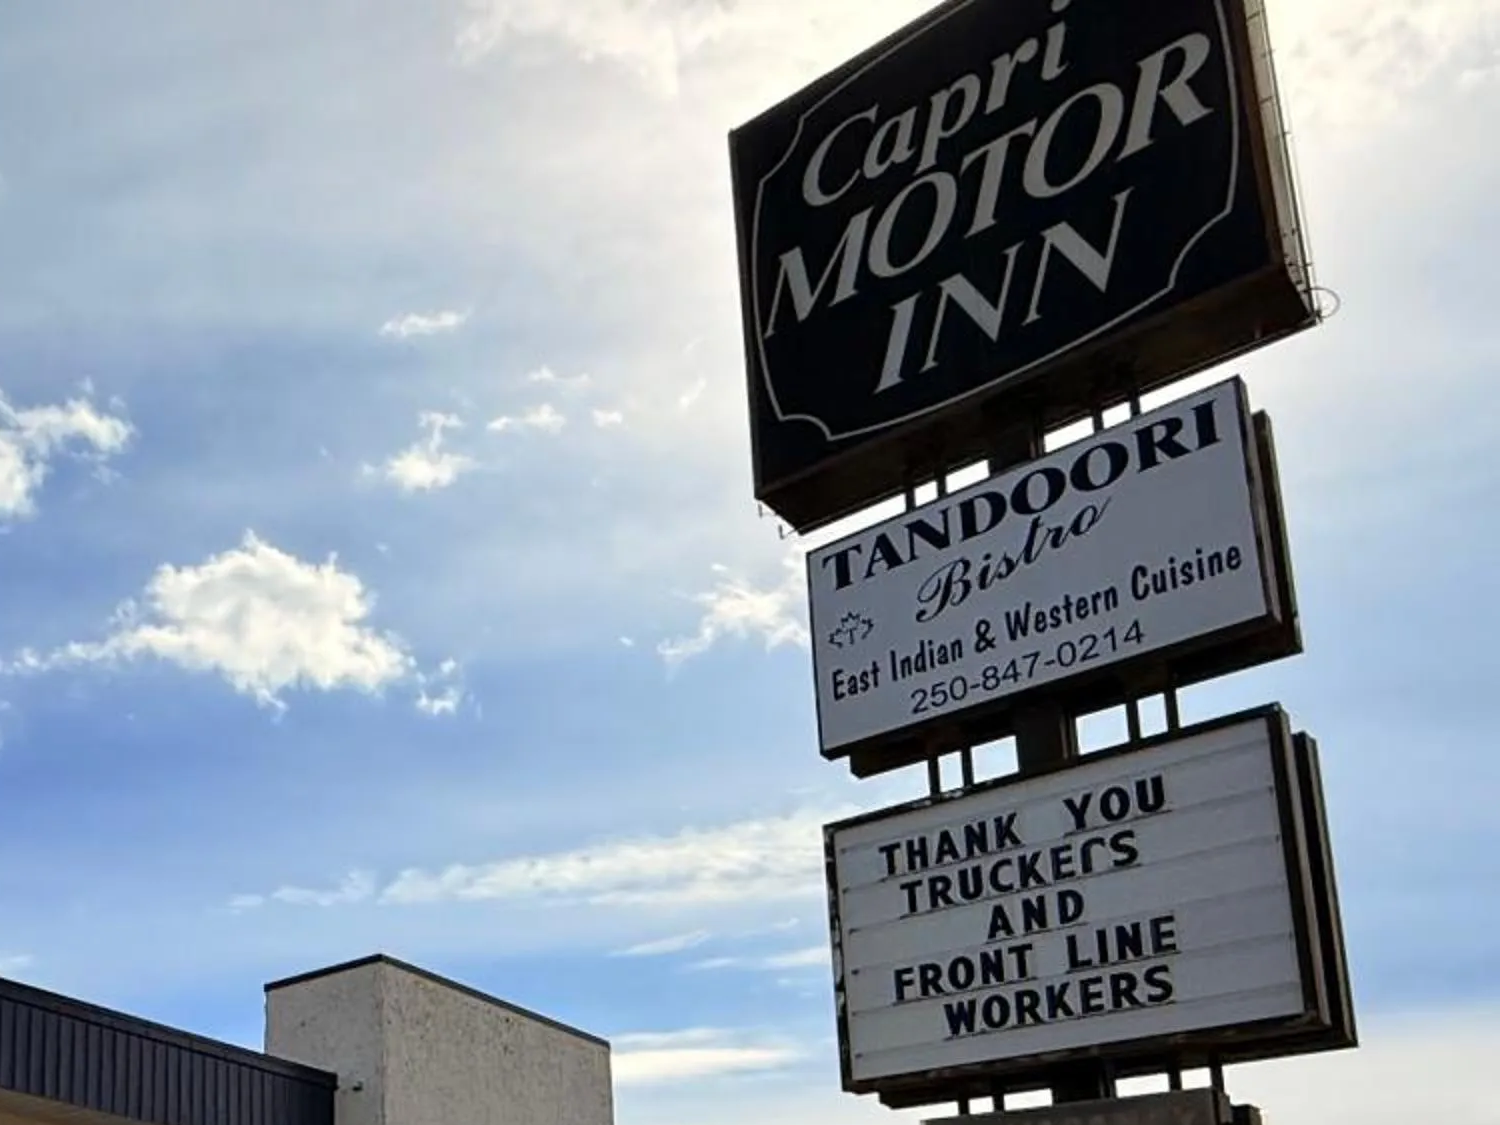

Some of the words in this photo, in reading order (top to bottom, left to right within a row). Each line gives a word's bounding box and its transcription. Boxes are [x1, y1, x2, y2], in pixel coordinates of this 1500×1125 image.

[803, 0, 1072, 206] Capri
[764, 32, 1214, 339] MOTOR
[874, 187, 1134, 394] INN
[822, 399, 1221, 591] TANDOORI
[916, 496, 1112, 622] Bistro
[831, 659, 880, 700] East
[890, 639, 963, 682] Indian
[975, 619, 997, 654] &
[1005, 586, 1119, 641] Western
[1131, 545, 1242, 600] Cuisine
[911, 619, 1145, 714] 250-847-0214
[879, 812, 1022, 877] THANK
[1064, 775, 1166, 832] YOU
[894, 943, 1035, 1001] FRONT
[1066, 915, 1178, 969] LINE
[987, 888, 1085, 939] AND
[944, 965, 1174, 1035] WORKERS
